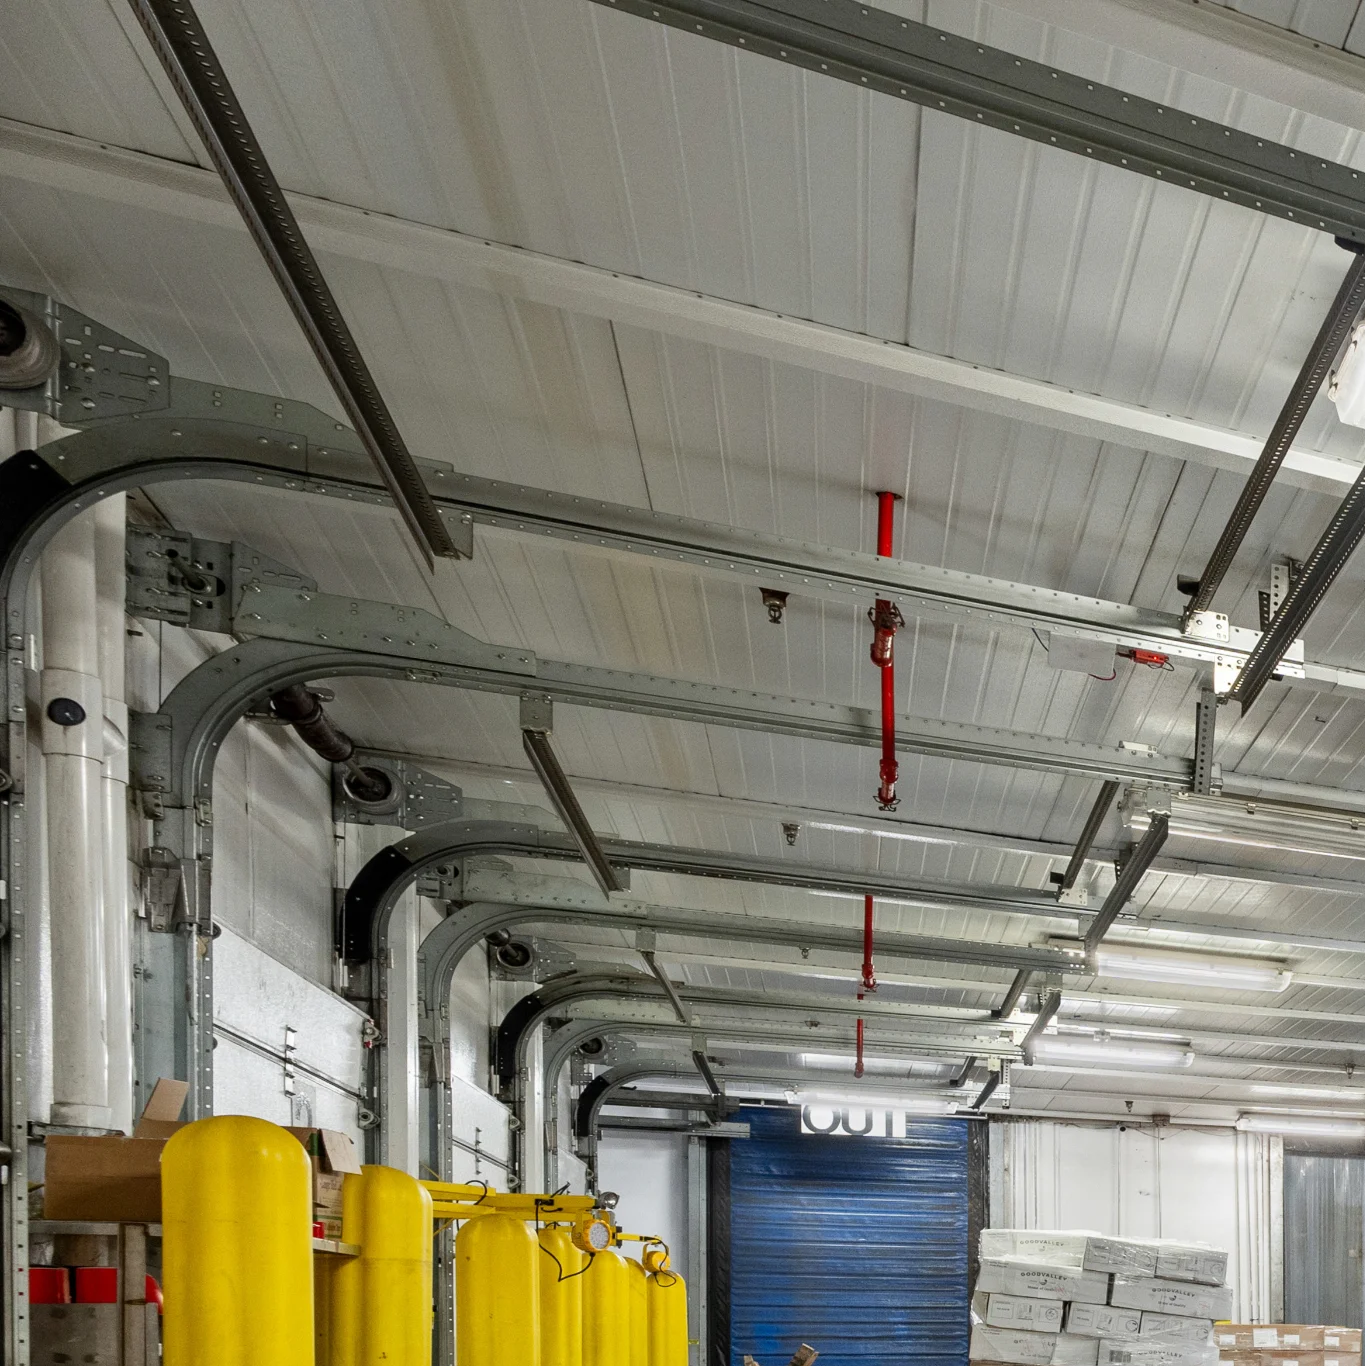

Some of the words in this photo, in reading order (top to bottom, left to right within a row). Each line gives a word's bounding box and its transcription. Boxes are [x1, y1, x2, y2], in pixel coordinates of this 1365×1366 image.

[1019, 1239, 1065, 1247] GOODVALLEY
[1020, 1272, 1068, 1281] GOODVALLEY
[1152, 1287, 1196, 1298] GOODVALLEY
